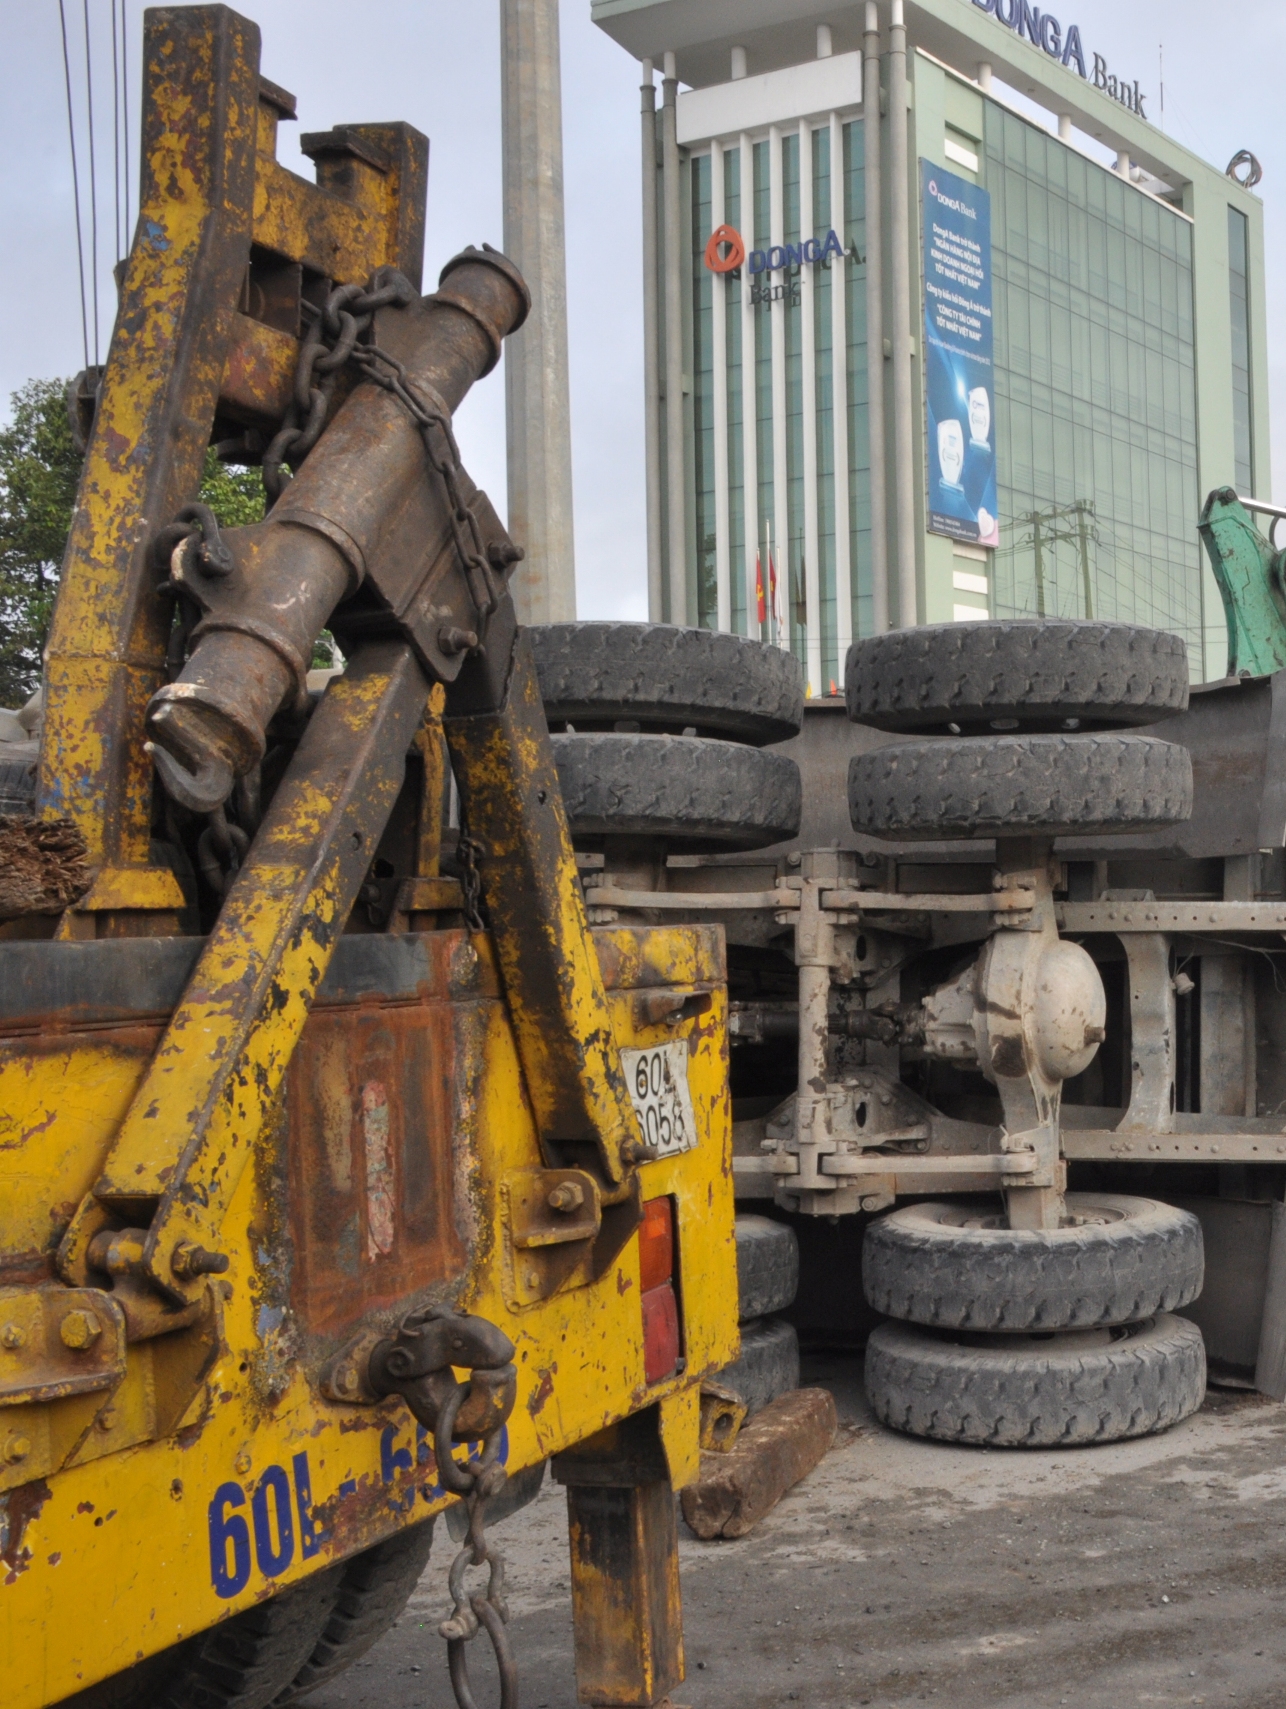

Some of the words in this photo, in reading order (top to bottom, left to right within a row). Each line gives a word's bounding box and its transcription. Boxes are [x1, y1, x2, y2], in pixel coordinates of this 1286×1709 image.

[971, 0, 1087, 79] ONGA
[1093, 52, 1147, 120] Bank
[938, 193, 960, 212] DONGA
[961, 202, 977, 220] Bank
[749, 230, 845, 275] DONGA
[750, 282, 801, 305] Bank
[208, 1451, 332, 1599] 60L
